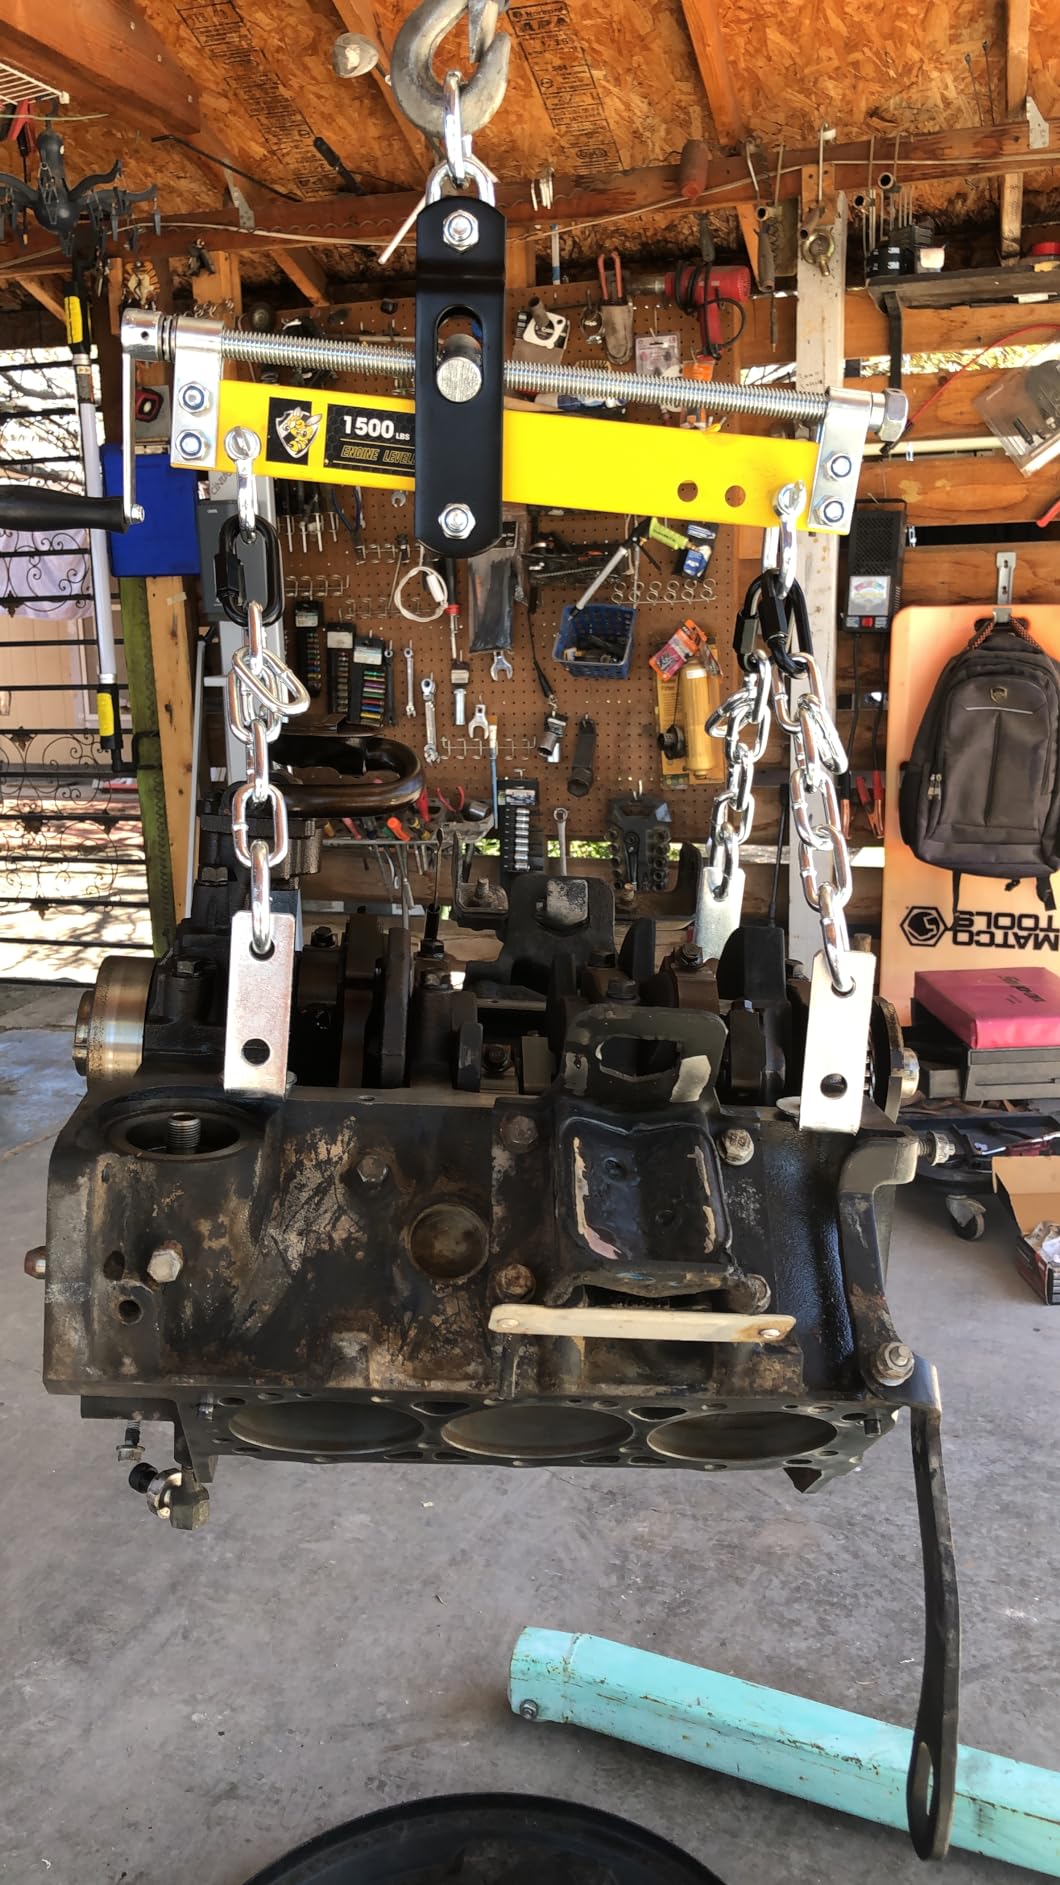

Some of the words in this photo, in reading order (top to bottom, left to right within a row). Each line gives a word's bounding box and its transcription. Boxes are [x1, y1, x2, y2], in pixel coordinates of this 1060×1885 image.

[343, 415, 394, 439] 1500
[395, 432, 411, 441] LBS
[341, 445, 380, 461] ENGINE
[956, 910, 1060, 933] TOOLS
[952, 929, 1060, 952] MATCO
